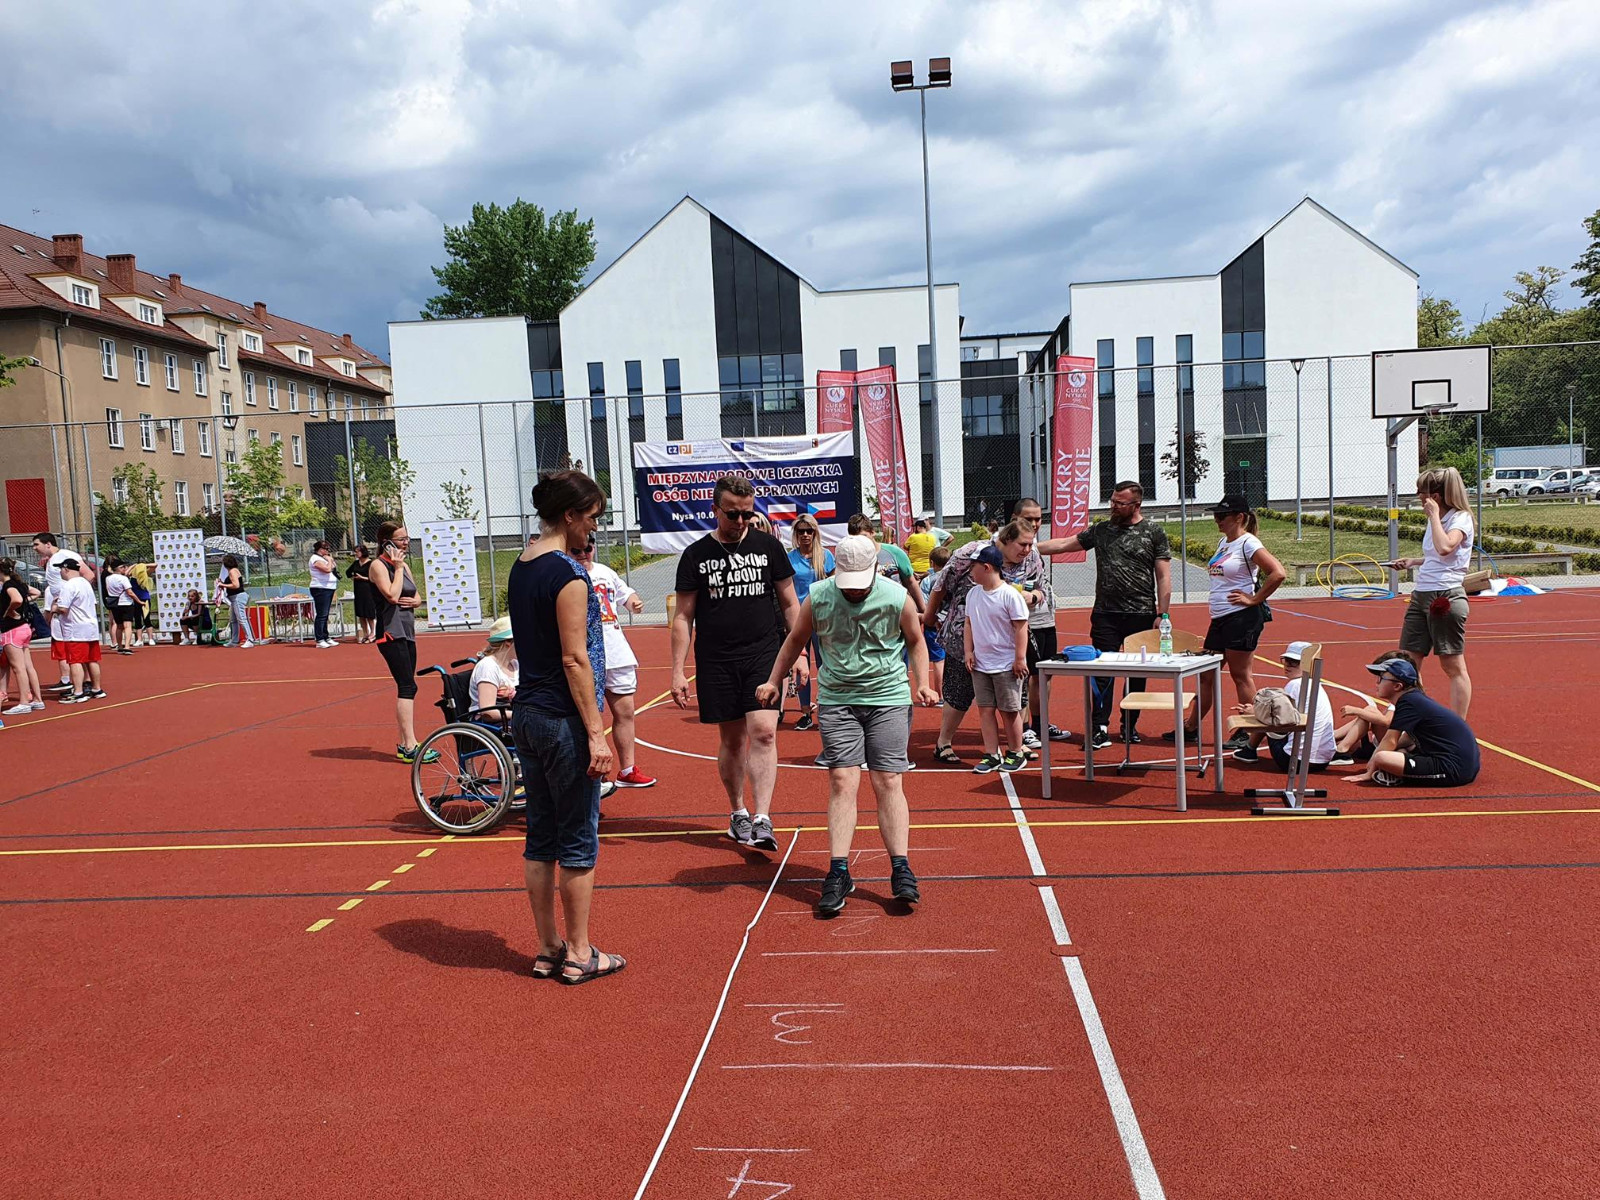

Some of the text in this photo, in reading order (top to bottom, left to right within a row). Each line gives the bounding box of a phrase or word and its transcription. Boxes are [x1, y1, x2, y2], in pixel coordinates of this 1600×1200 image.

[778, 463, 843, 479] IGRZYSKA
[653, 481, 839, 502] OSÓB NIESPRAWNYCH
[1055, 450, 1073, 527] CUKRY
[1072, 447, 1091, 528] NYSKIE
[672, 511, 715, 522] Nysa 10.0
[699, 552, 768, 574] STOP ASKING
[708, 567, 762, 587] ME ABOUT
[708, 582, 765, 599] MY FUTURE
[771, 1009, 845, 1045] 3
[726, 1159, 795, 1200] 4
